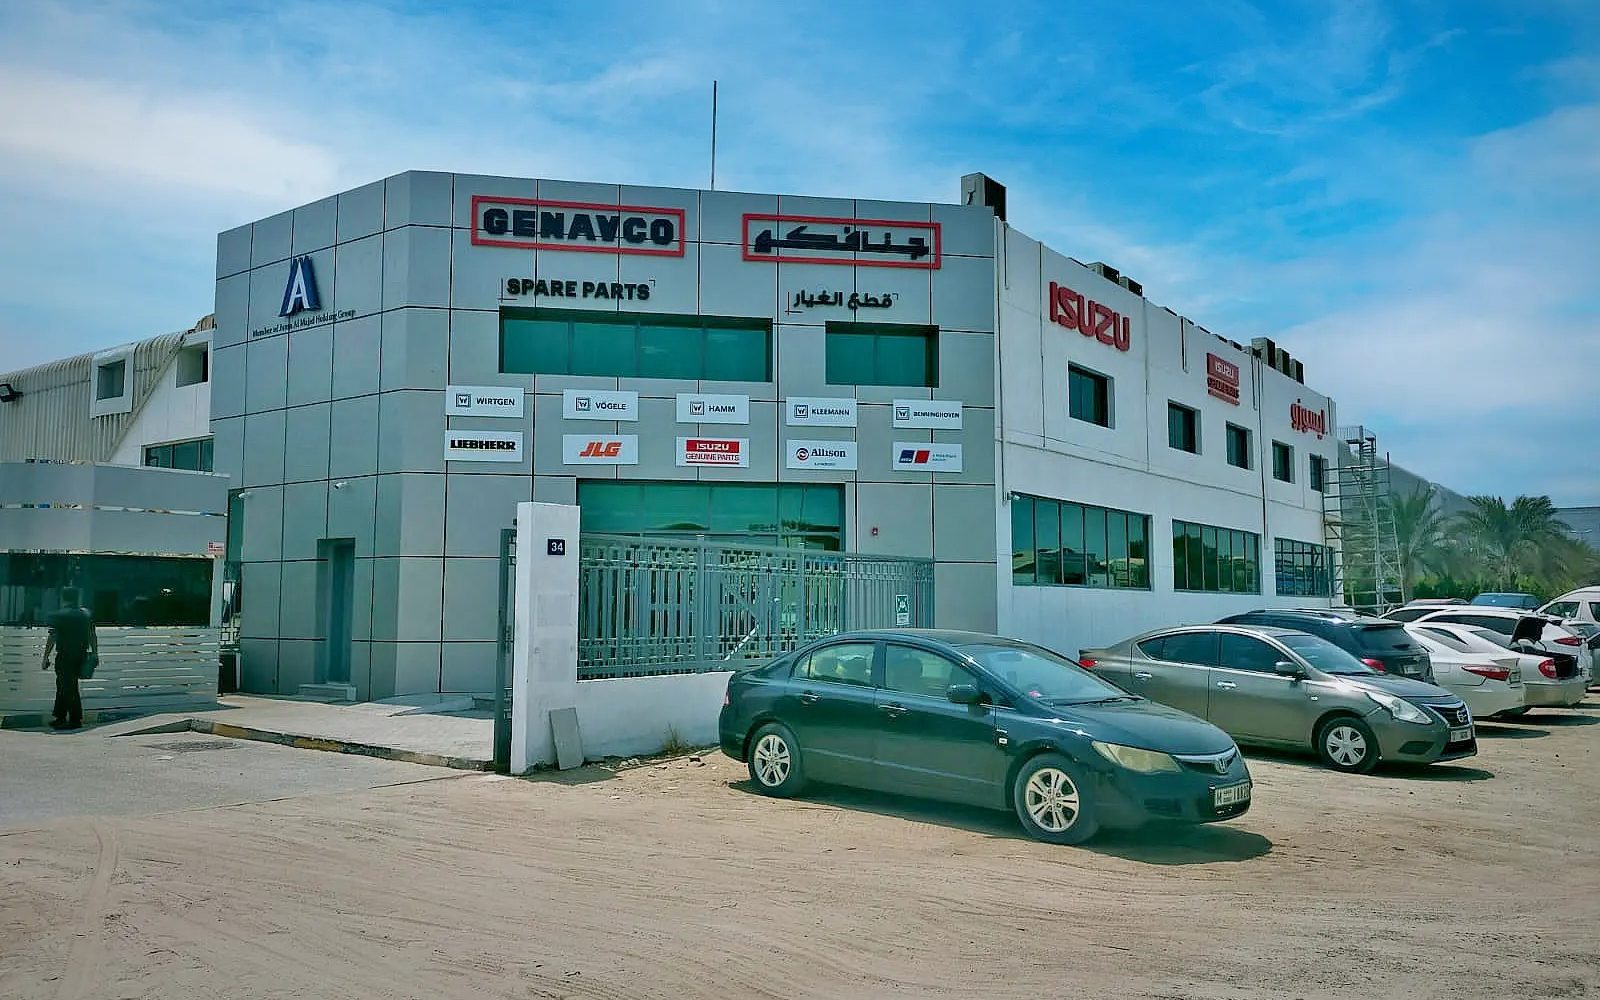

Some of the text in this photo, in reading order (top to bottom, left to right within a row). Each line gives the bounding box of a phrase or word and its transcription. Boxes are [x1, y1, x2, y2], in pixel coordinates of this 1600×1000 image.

[484, 208, 674, 245] GENAVCO
[507, 278, 650, 300] SPARE PARTS
[794, 289, 893, 311] قطع الغيار
[1049, 281, 1130, 352] ISUZU
[476, 397, 515, 406] WIRTGEN
[708, 405, 736, 413] HAMM
[450, 439, 516, 451] LIEBHERR
[579, 442, 622, 457] JLG
[696, 442, 730, 451] ISUZU
[686, 452, 740, 461] GENUINE PARTS
[811, 448, 846, 458] Allison
[551, 542, 563, 552] 34
